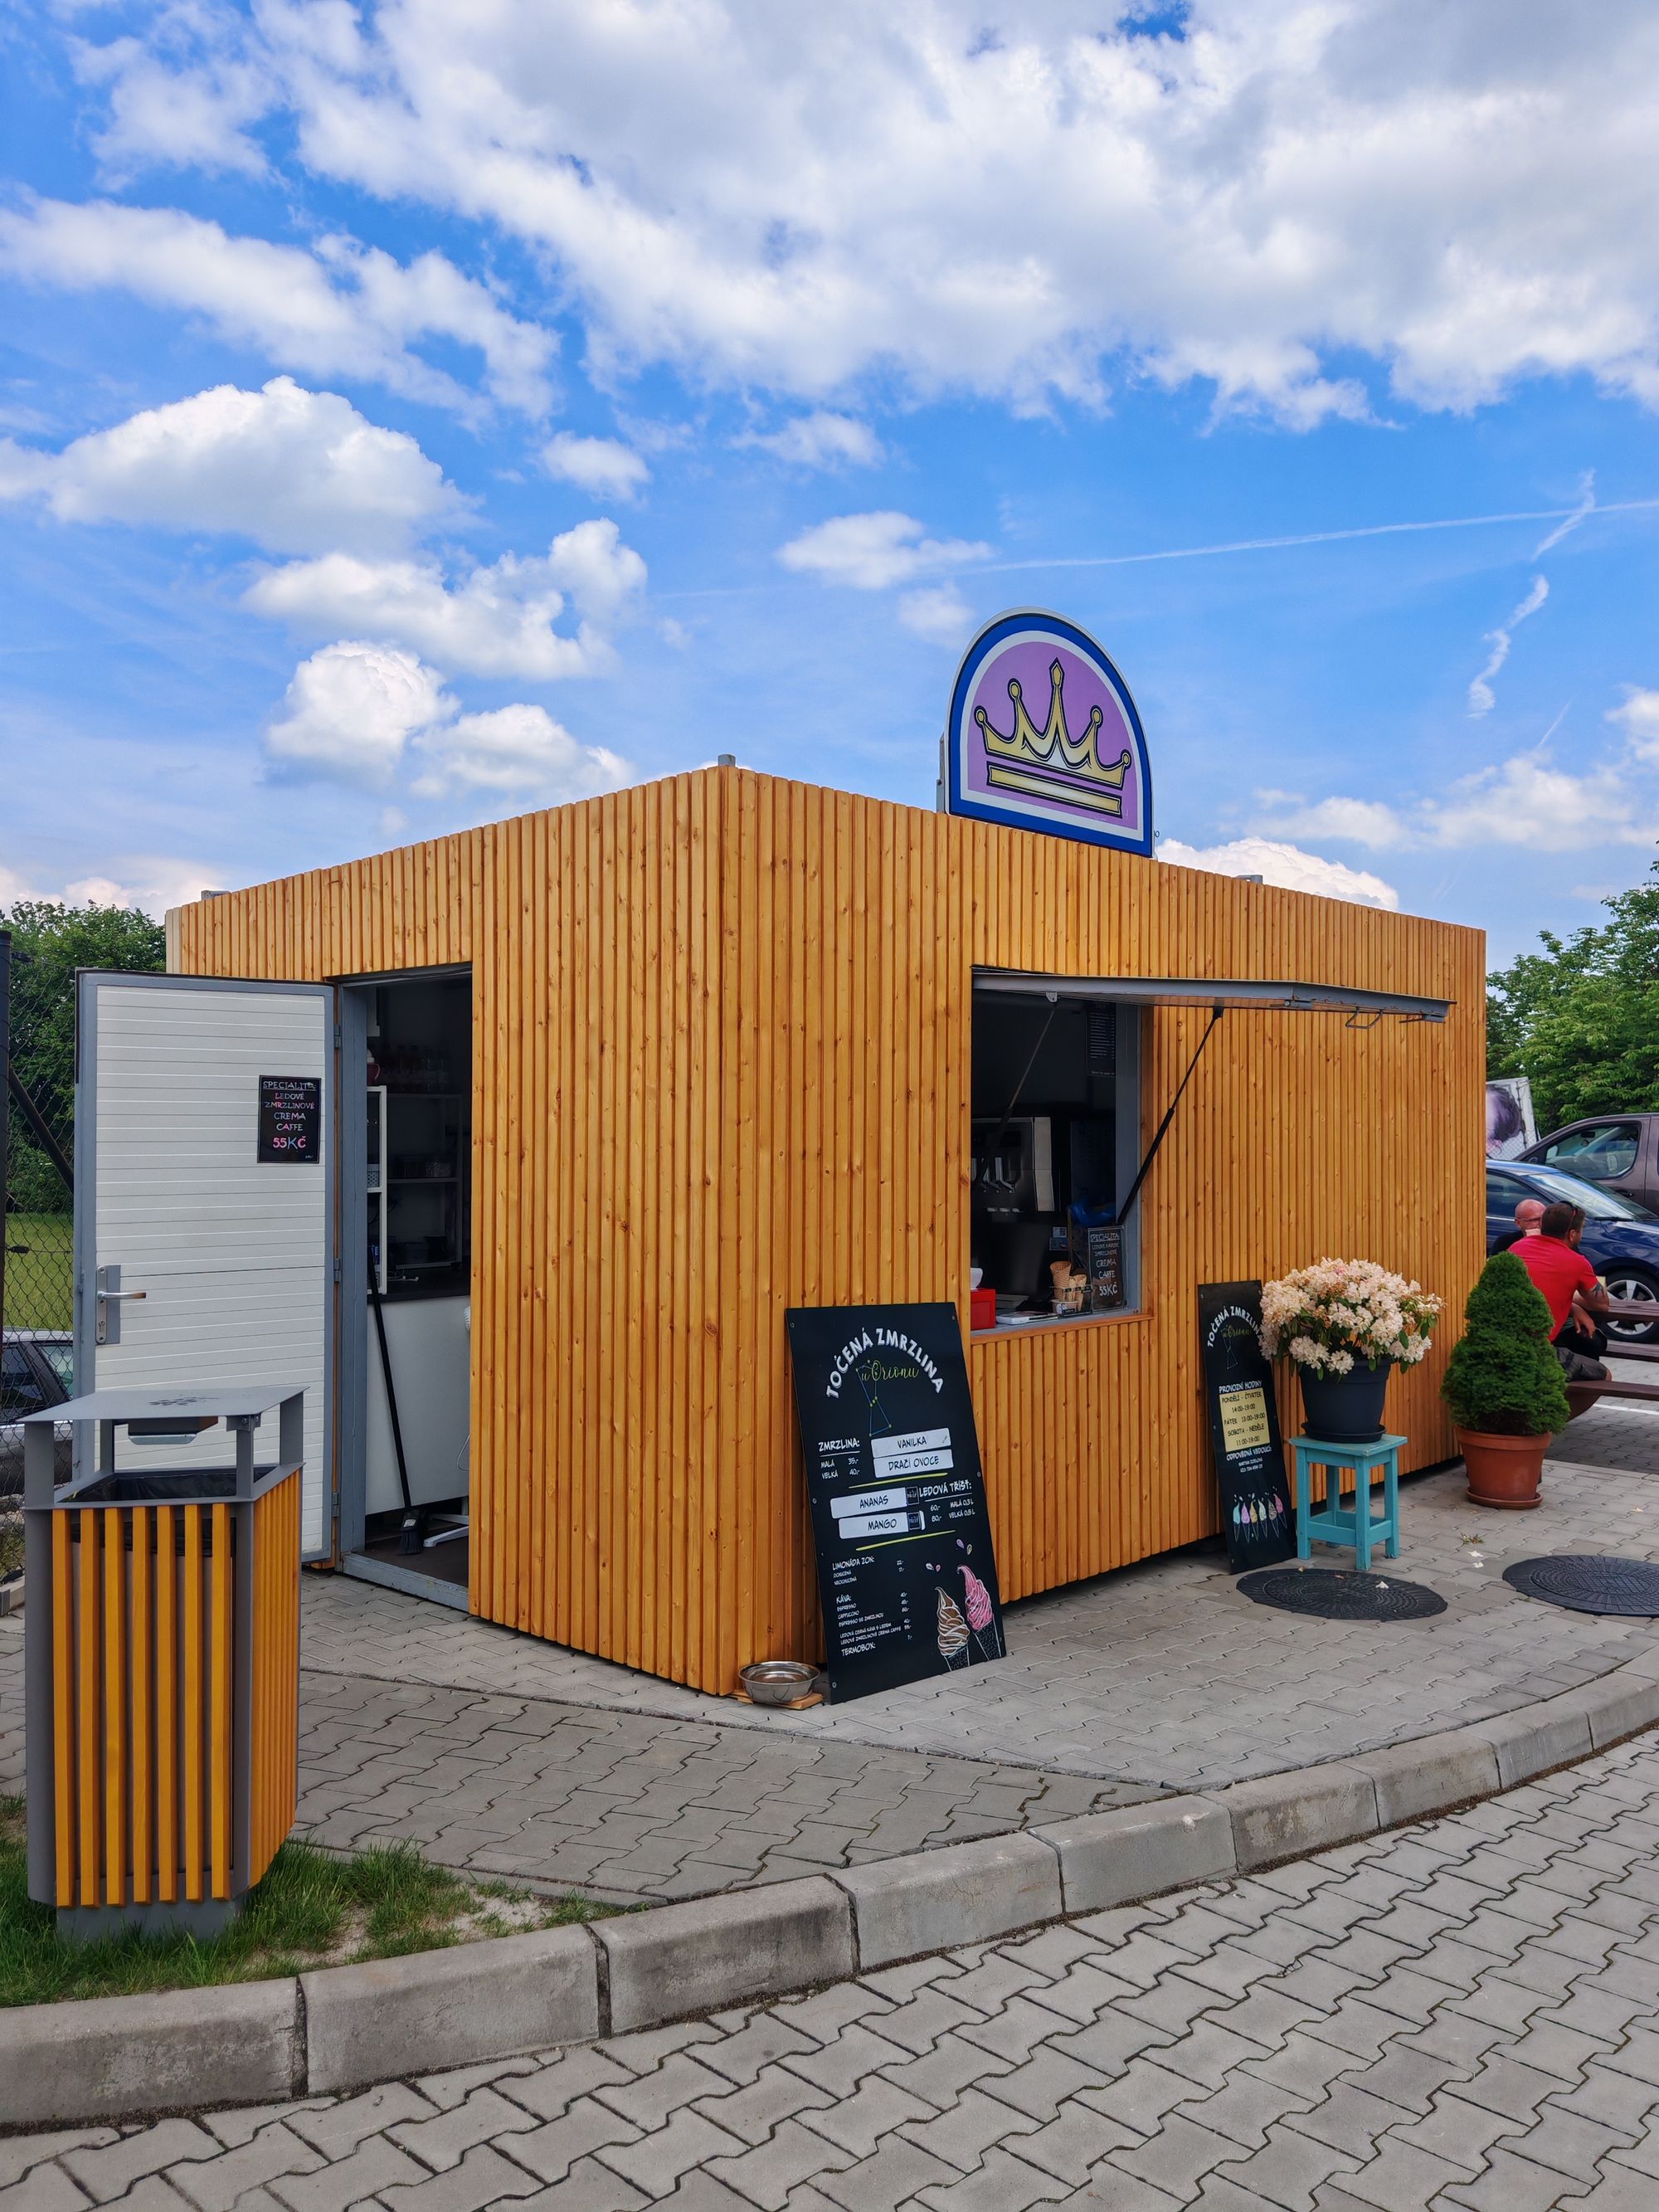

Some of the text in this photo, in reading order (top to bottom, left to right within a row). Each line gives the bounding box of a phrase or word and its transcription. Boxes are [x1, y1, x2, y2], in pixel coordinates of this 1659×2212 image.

[275, 1092, 304, 1100] LEDOVÉ
[274, 1112, 306, 1121] CREMA
[273, 1136, 306, 1149] 55KČ
[1096, 1259, 1117, 1268] CREMA
[1098, 1270, 1115, 1279] CAFFE
[1099, 1282, 1118, 1296] 55KČ
[1207, 1305, 1229, 1348] TOČENÁ
[825, 1328, 944, 1399] TOČENÁ ZMRZLINA
[1219, 1381, 1243, 1394] PROVOZNÍ
[1224, 1415, 1238, 1425] PÁTEK
[1228, 1427, 1244, 1437] SOBOTA
[818, 1437, 860, 1452] ZMRZLINA:
[897, 1435, 927, 1449] VANILKA
[820, 1459, 835, 1469] MALÁ
[888, 1455, 939, 1471] DRAČÍ OVOCE
[821, 1469, 839, 1479] VELKÁ
[919, 1482, 948, 1498] LEDOVÁ
[859, 1494, 888, 1509] ANANAS
[950, 1498, 962, 1508] MALÁ
[948, 1509, 963, 1519] VELKÁ
[868, 1518, 897, 1532] MANGO
[832, 1557, 860, 1571] LIMONÁDA
[836, 1594, 852, 1605] KÁVA:
[841, 1642, 876, 1657] TERMOBOX:
